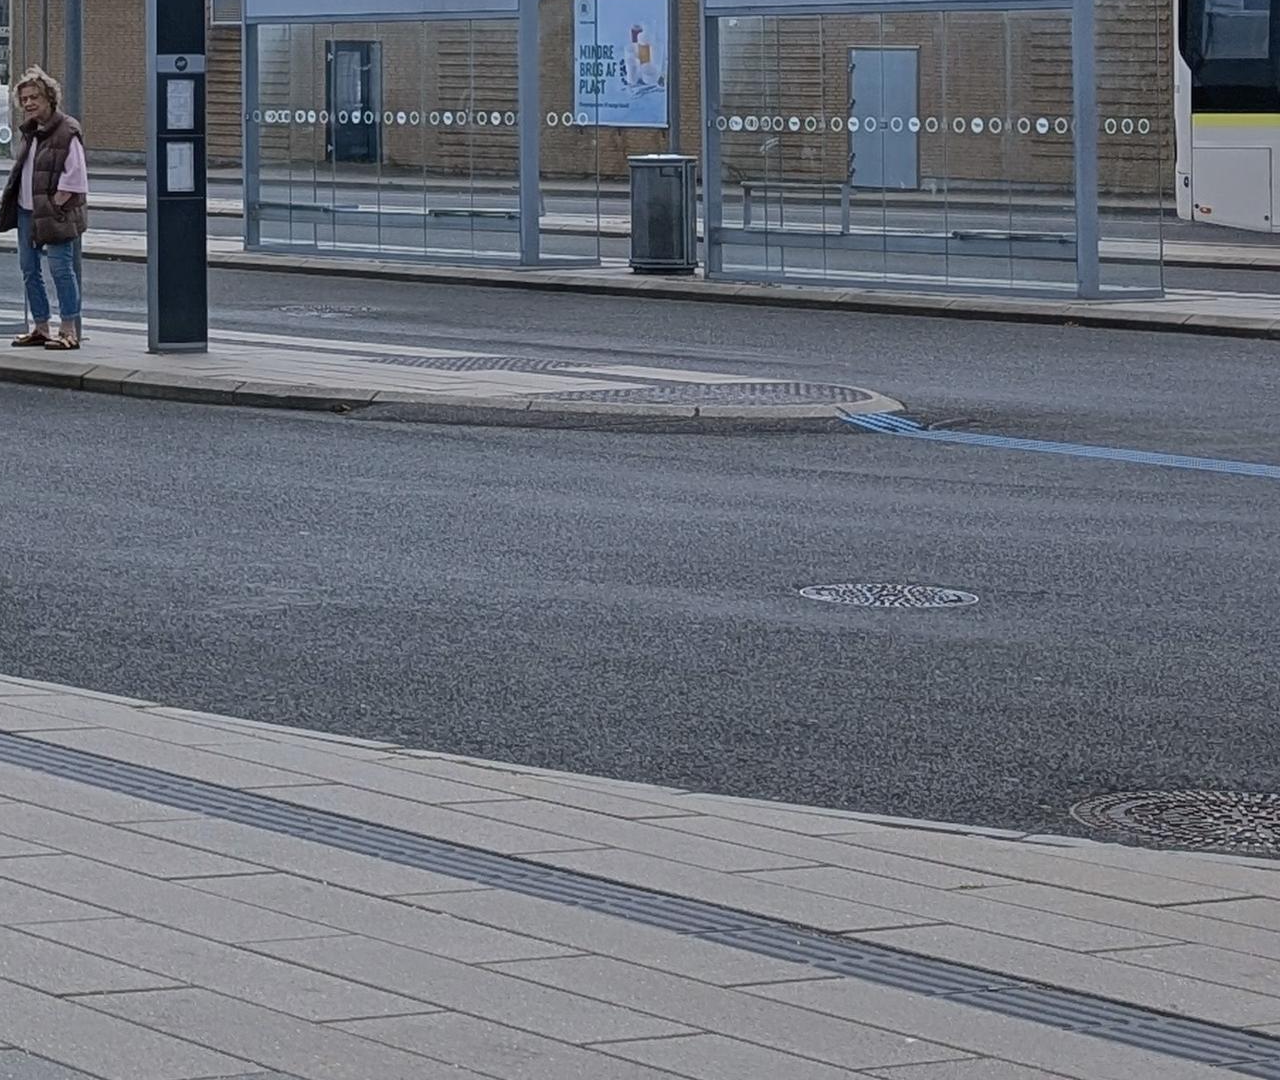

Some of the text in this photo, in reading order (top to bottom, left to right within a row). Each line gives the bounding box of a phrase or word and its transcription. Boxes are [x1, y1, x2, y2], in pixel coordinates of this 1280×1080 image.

[580, 44, 614, 60] MINDRE
[605, 62, 618, 77] AF
[579, 79, 607, 95] PLAST
